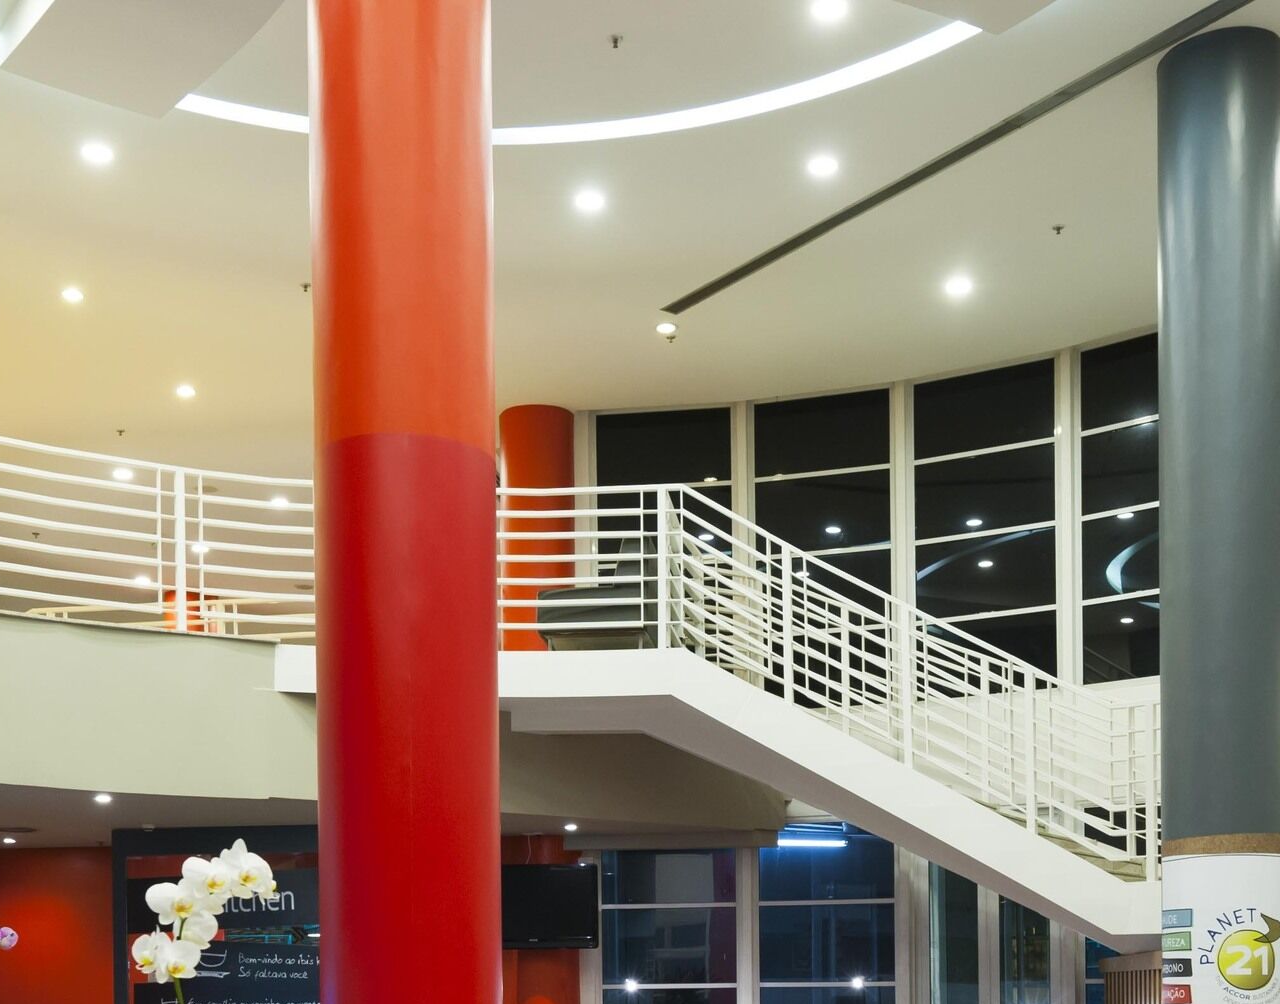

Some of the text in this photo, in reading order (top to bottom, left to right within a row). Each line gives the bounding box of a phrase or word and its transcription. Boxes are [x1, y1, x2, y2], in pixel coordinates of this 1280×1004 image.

[224, 890, 295, 913] itchen
[1197, 907, 1257, 965] PLANET
[284, 957, 296, 965] ao
[1225, 944, 1269, 976] 21
[1223, 986, 1251, 1000] ACCOR
